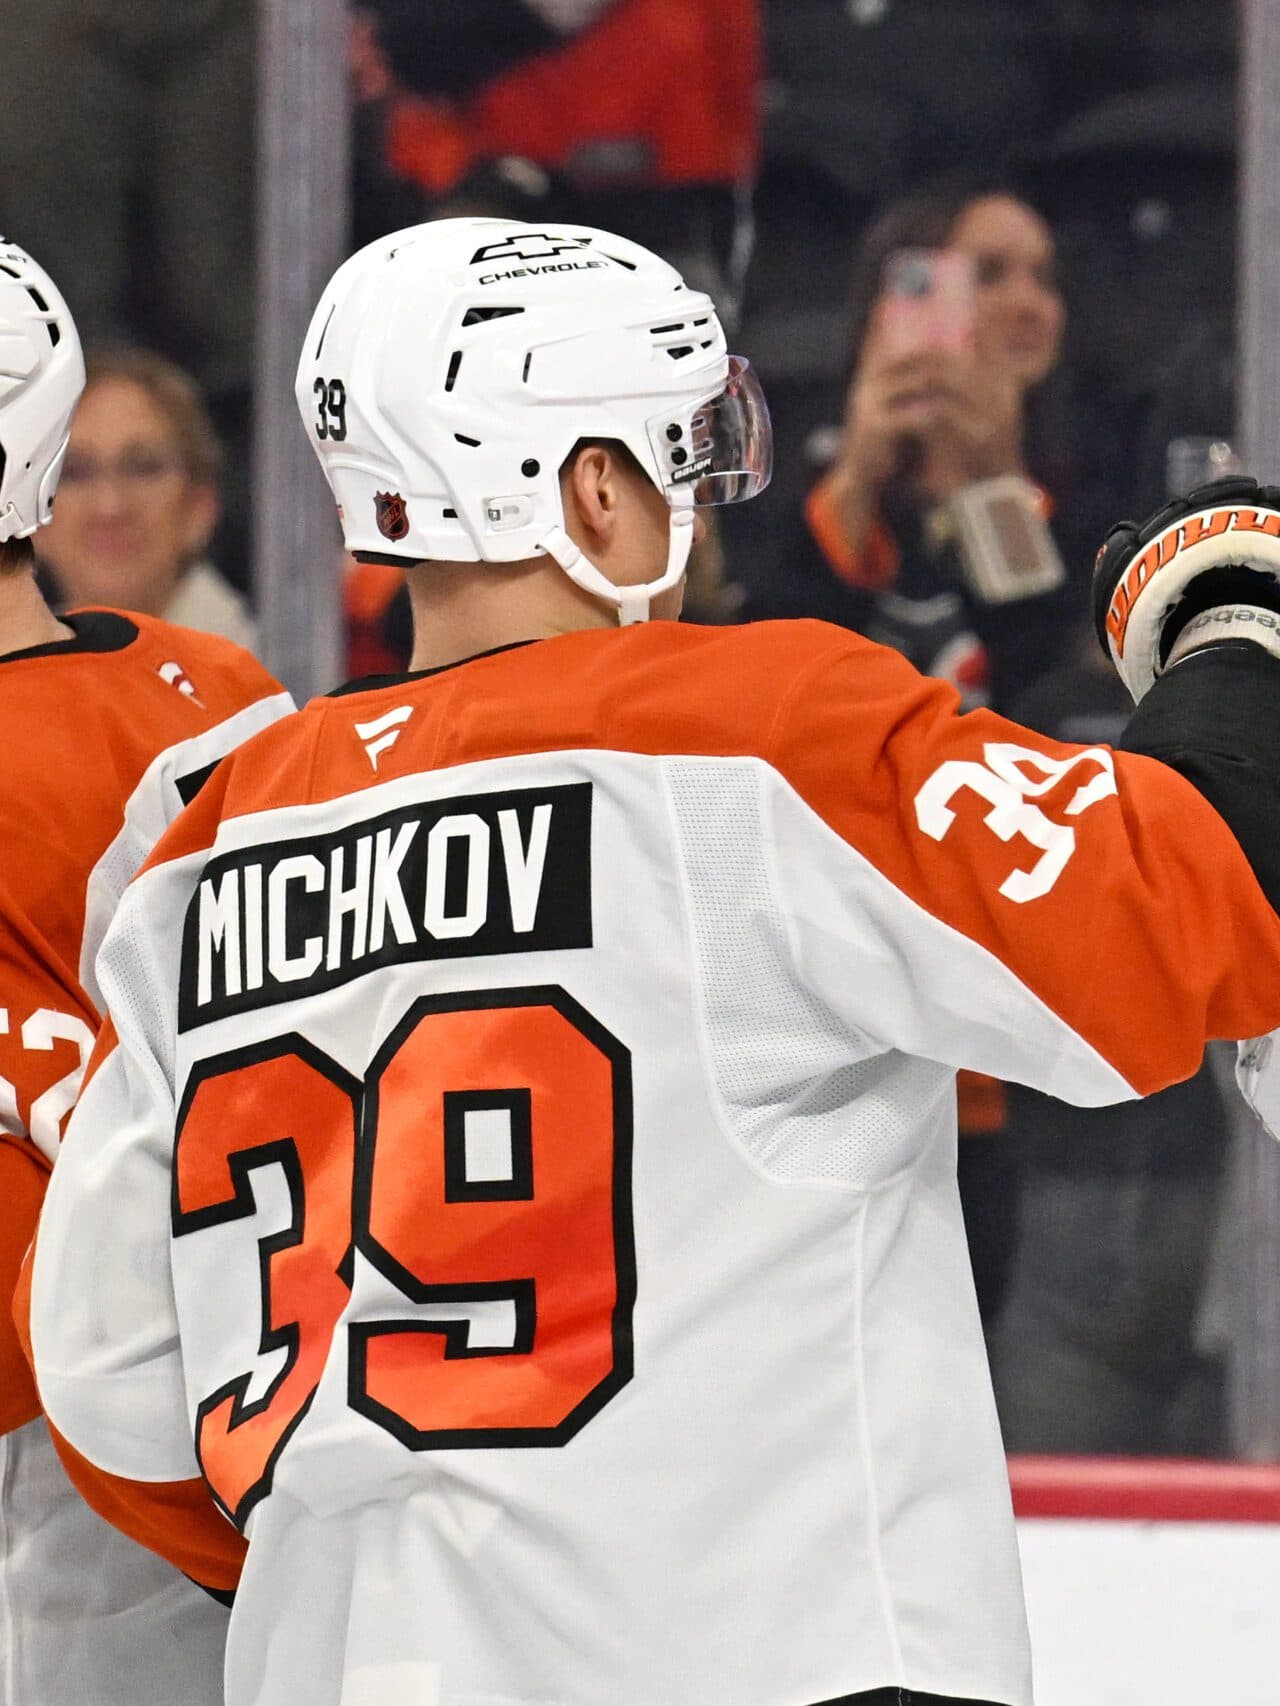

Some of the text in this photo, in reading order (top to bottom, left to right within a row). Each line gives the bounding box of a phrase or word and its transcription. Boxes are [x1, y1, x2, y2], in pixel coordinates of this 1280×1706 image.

[313, 376, 348, 442] 39
[197, 803, 553, 1007] MICHKOV
[913, 742, 1119, 904] 39
[172, 984, 638, 1537] 39
